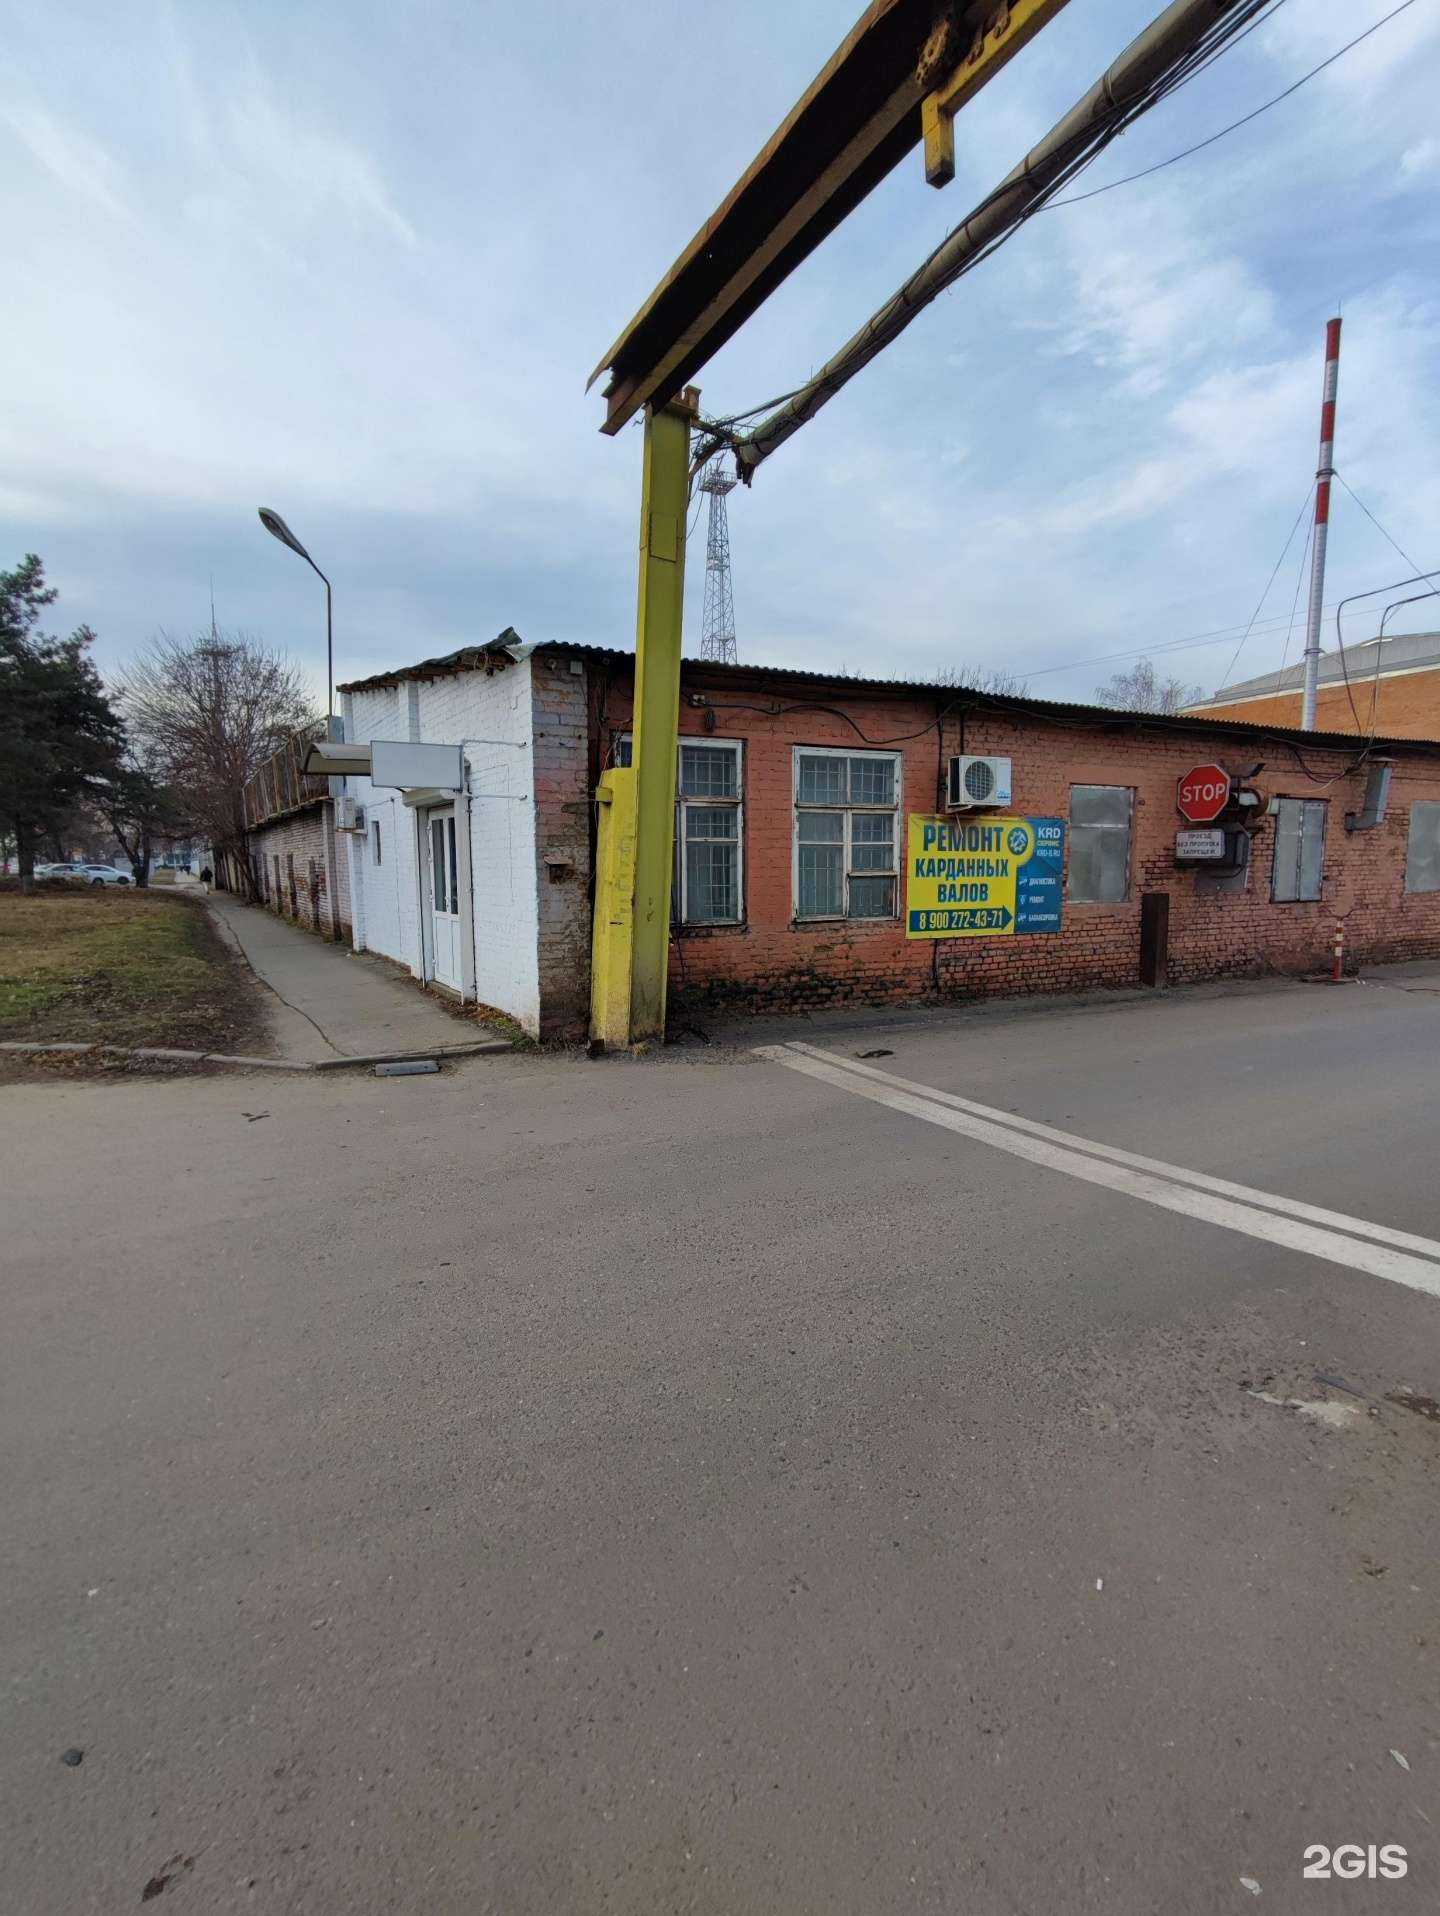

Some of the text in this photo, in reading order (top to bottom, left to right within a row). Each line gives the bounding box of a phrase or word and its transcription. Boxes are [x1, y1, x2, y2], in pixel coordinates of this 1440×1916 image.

[1182, 783, 1225, 802] STOP
[923, 825, 1004, 852] РЕМОНТ
[1038, 827, 1061, 839] KRD
[915, 858, 1009, 880] КАРДАННЫХ
[938, 883, 989, 903] ВАЛОВ
[919, 910, 1003, 930] 8 900 272-43-71
